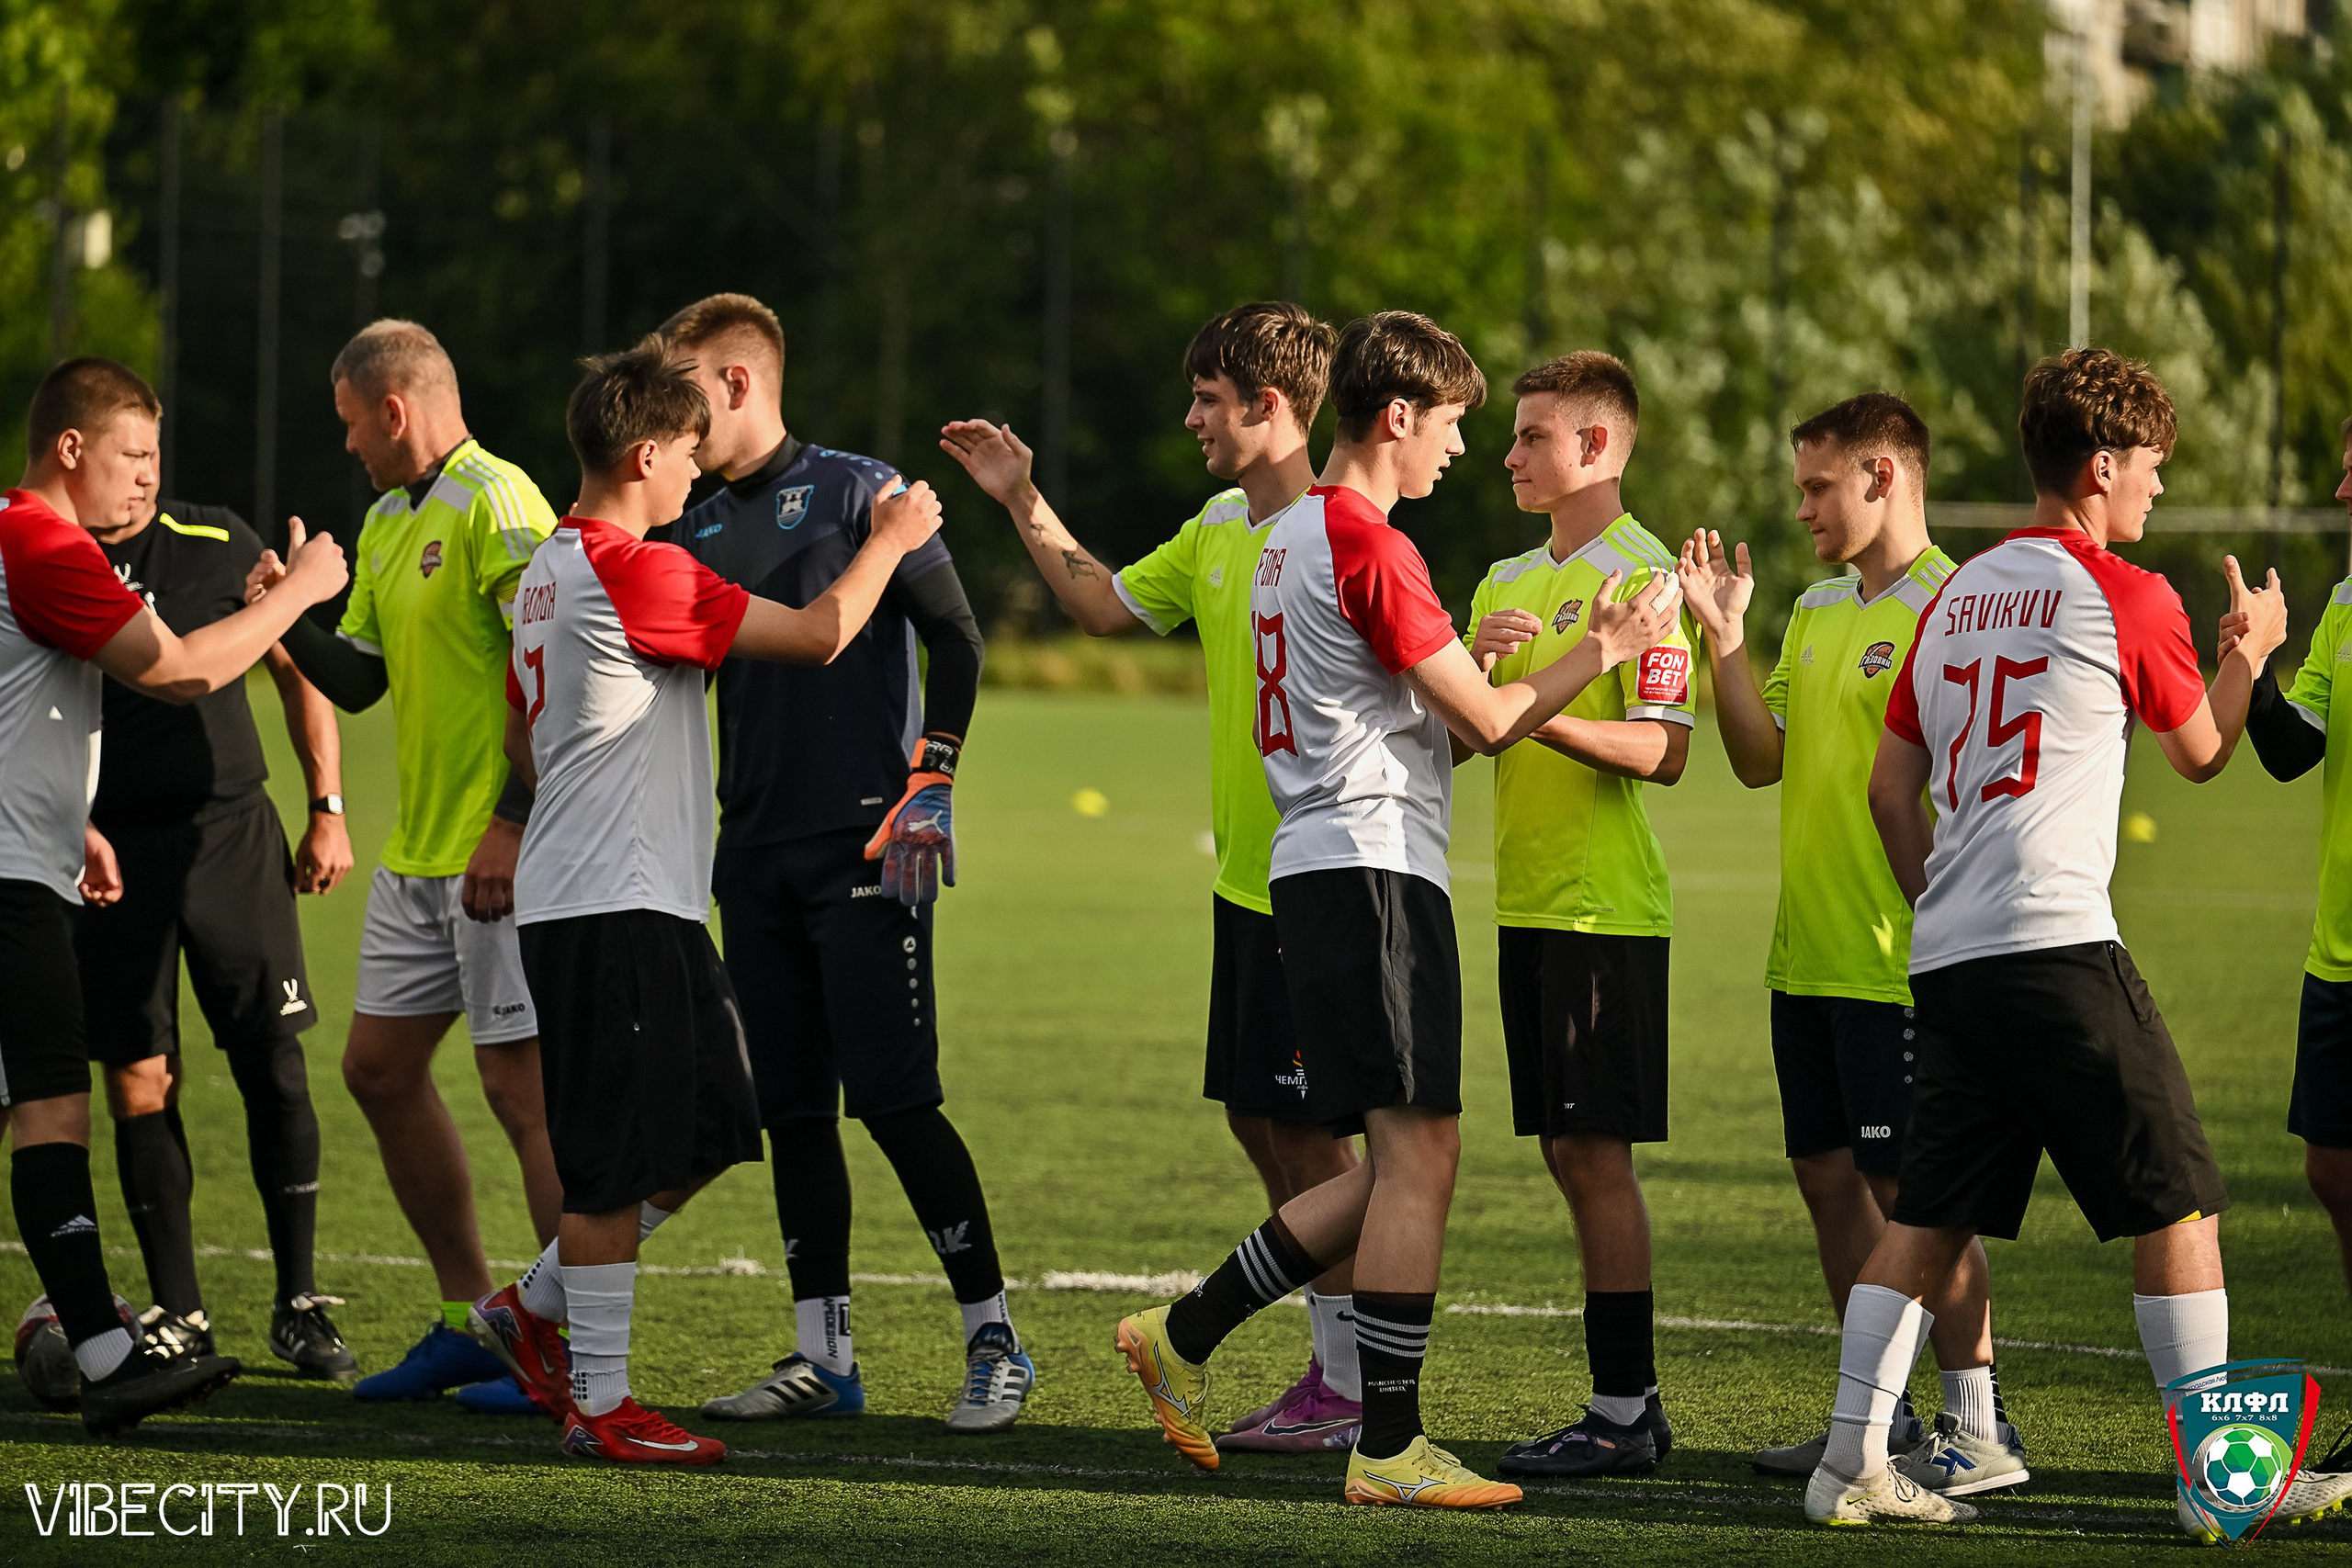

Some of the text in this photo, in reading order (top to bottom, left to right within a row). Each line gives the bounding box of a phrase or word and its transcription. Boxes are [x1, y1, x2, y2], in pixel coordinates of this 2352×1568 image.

[695, 524, 723, 538] JAKO
[1255, 548, 1286, 587] FOMA
[1944, 589, 2063, 637] SAVIKVV
[1646, 652, 1685, 671] FON
[1860, 655, 1891, 668] ГАЗОВИК
[1645, 669, 1682, 687] BET
[524, 644, 545, 742] 7
[1942, 655, 2050, 813] 75
[851, 885, 882, 897] JAKO
[1860, 1125, 1891, 1138] JAKO
